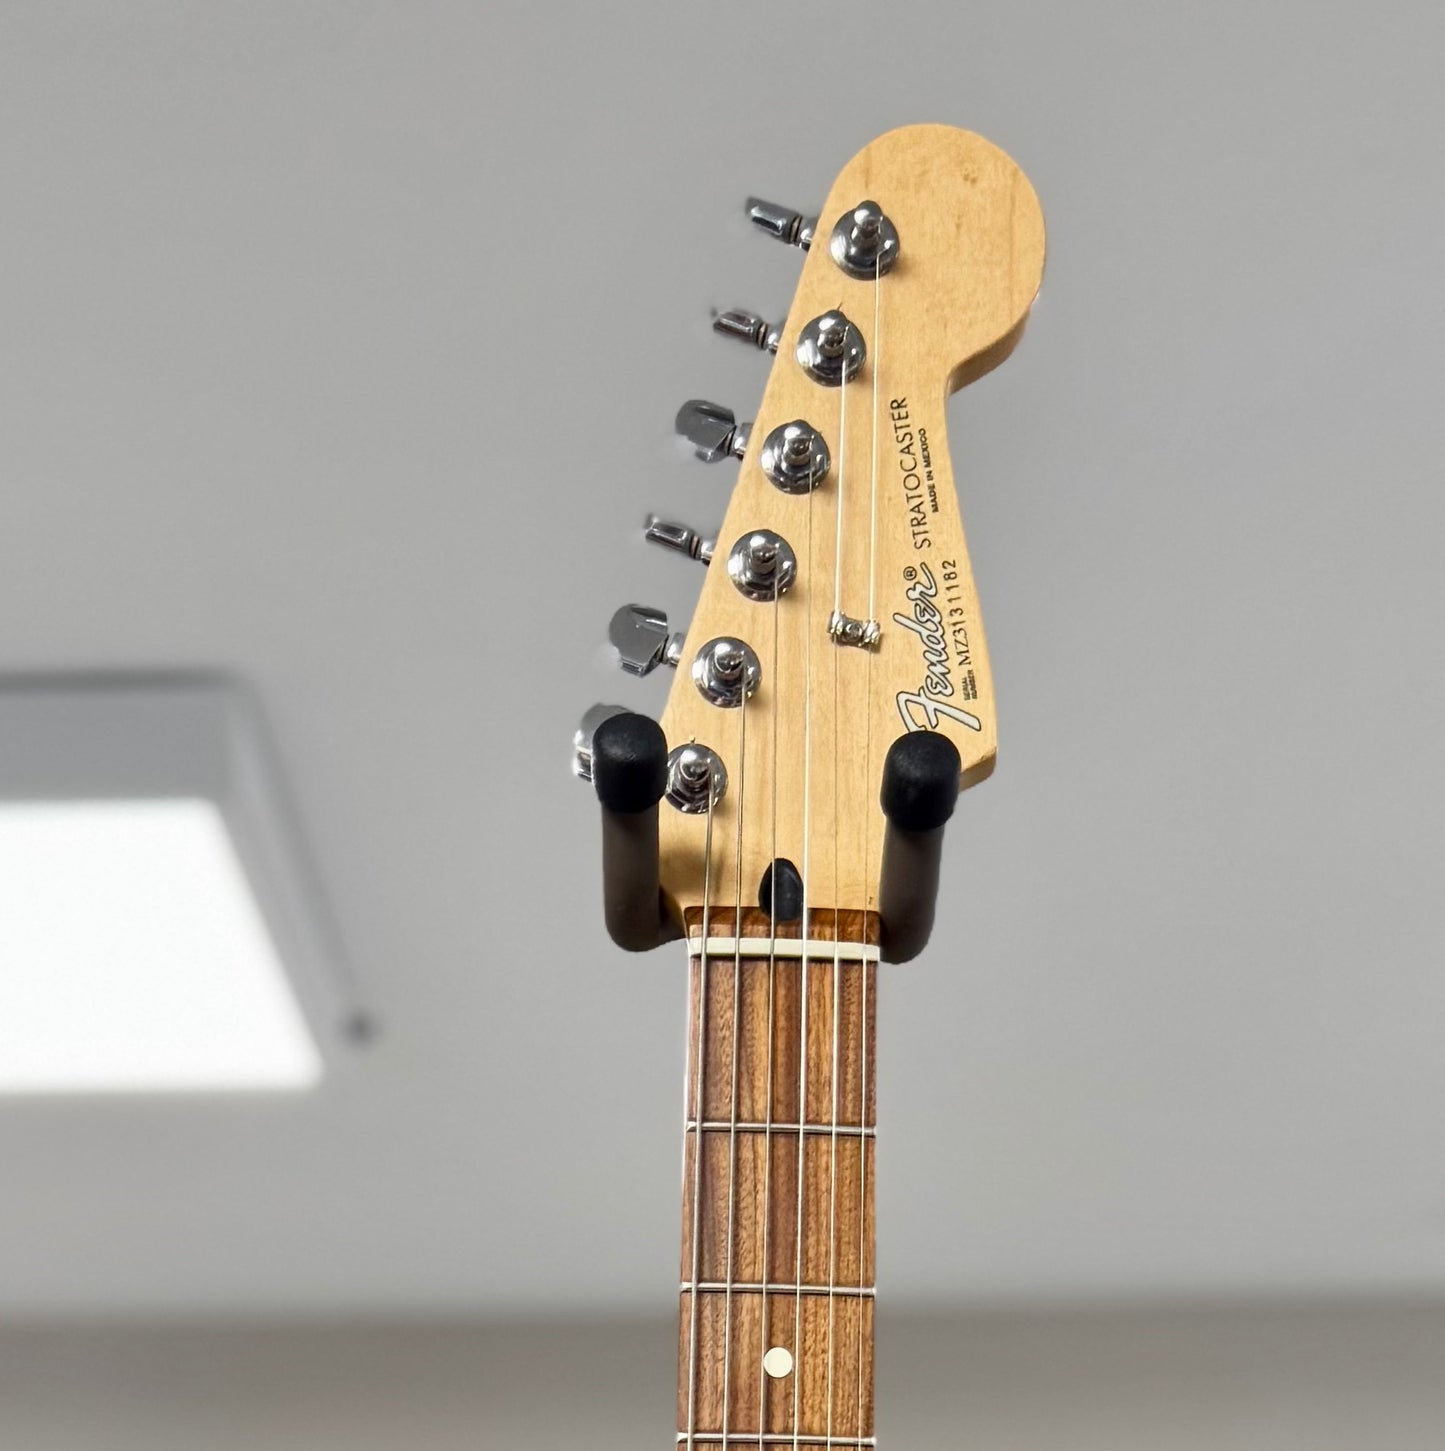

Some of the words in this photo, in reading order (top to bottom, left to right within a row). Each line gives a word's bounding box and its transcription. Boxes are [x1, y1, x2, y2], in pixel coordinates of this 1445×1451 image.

[917, 427, 932, 468] MEXICO
[889, 396, 932, 550] STRATOCASTER
[925, 470, 935, 482] IN
[926, 483, 940, 514] MADE
[941, 559, 972, 667] MZ3131182
[960, 676, 971, 702] SERIAL
[967, 669, 978, 700] NUMBER
